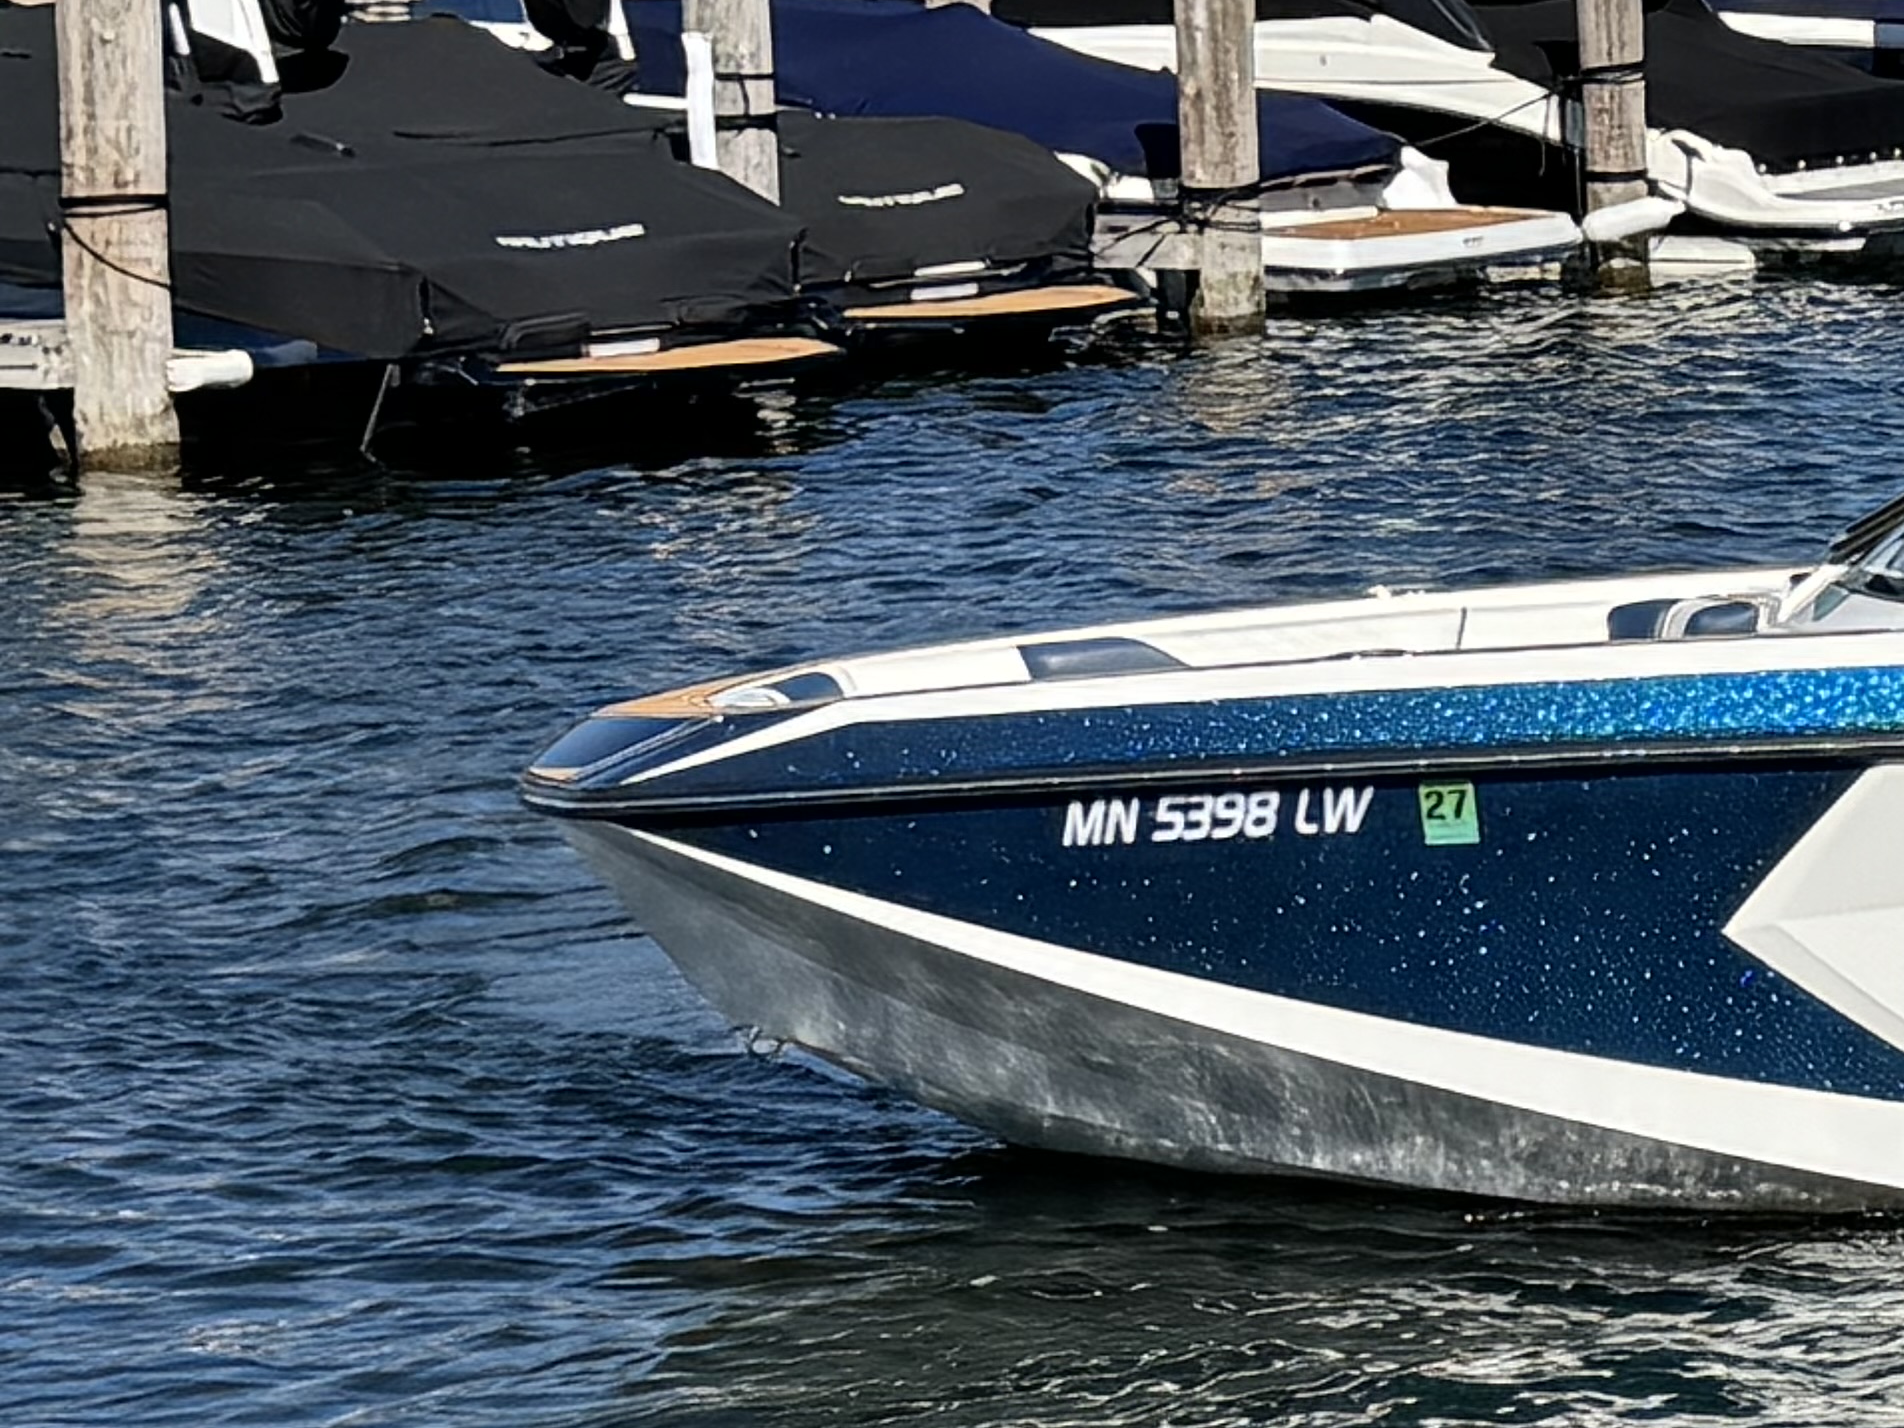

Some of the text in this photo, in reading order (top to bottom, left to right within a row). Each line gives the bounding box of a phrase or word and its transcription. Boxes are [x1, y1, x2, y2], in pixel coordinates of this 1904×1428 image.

[1062, 785, 1374, 846] MN 5398 LW
[1425, 789, 1467, 820] 27
